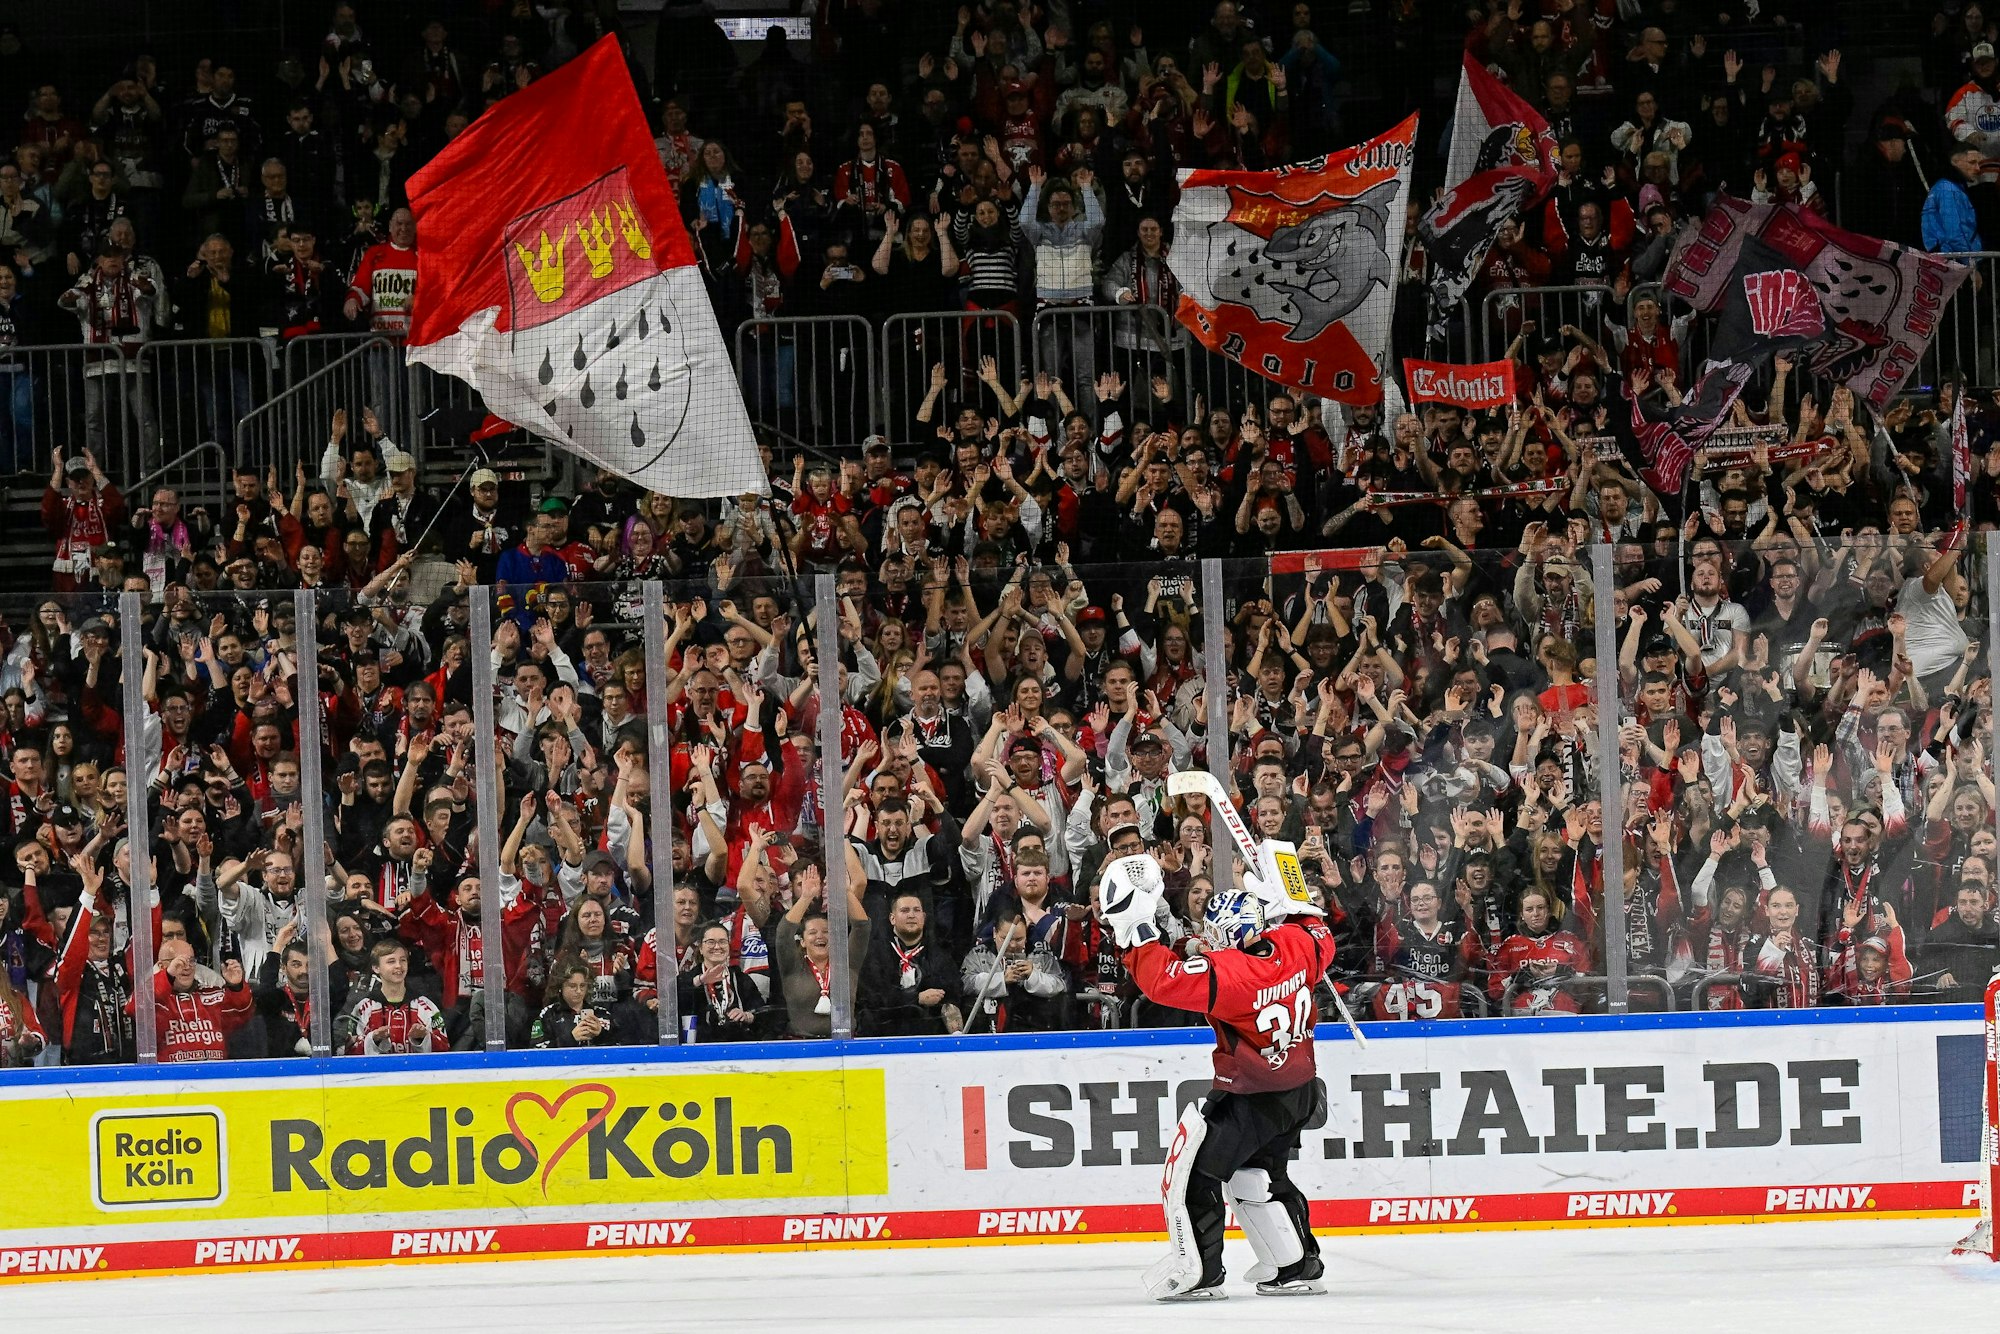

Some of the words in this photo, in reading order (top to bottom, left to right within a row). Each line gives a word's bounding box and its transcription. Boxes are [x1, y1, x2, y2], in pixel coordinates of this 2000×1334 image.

[1413, 367, 1505, 402] Colonia
[1283, 860, 1298, 896] Radio
[1289, 864, 1304, 894] Köln
[1384, 984, 1442, 1020] 45
[169, 1018, 223, 1033] Rhein
[1255, 985, 1312, 1056] 30
[165, 1029, 223, 1047] Energie
[116, 1129, 202, 1157] Radio
[271, 1107, 538, 1193] Radio
[587, 1097, 793, 1180] Köln
[126, 1159, 194, 1187] Köln
